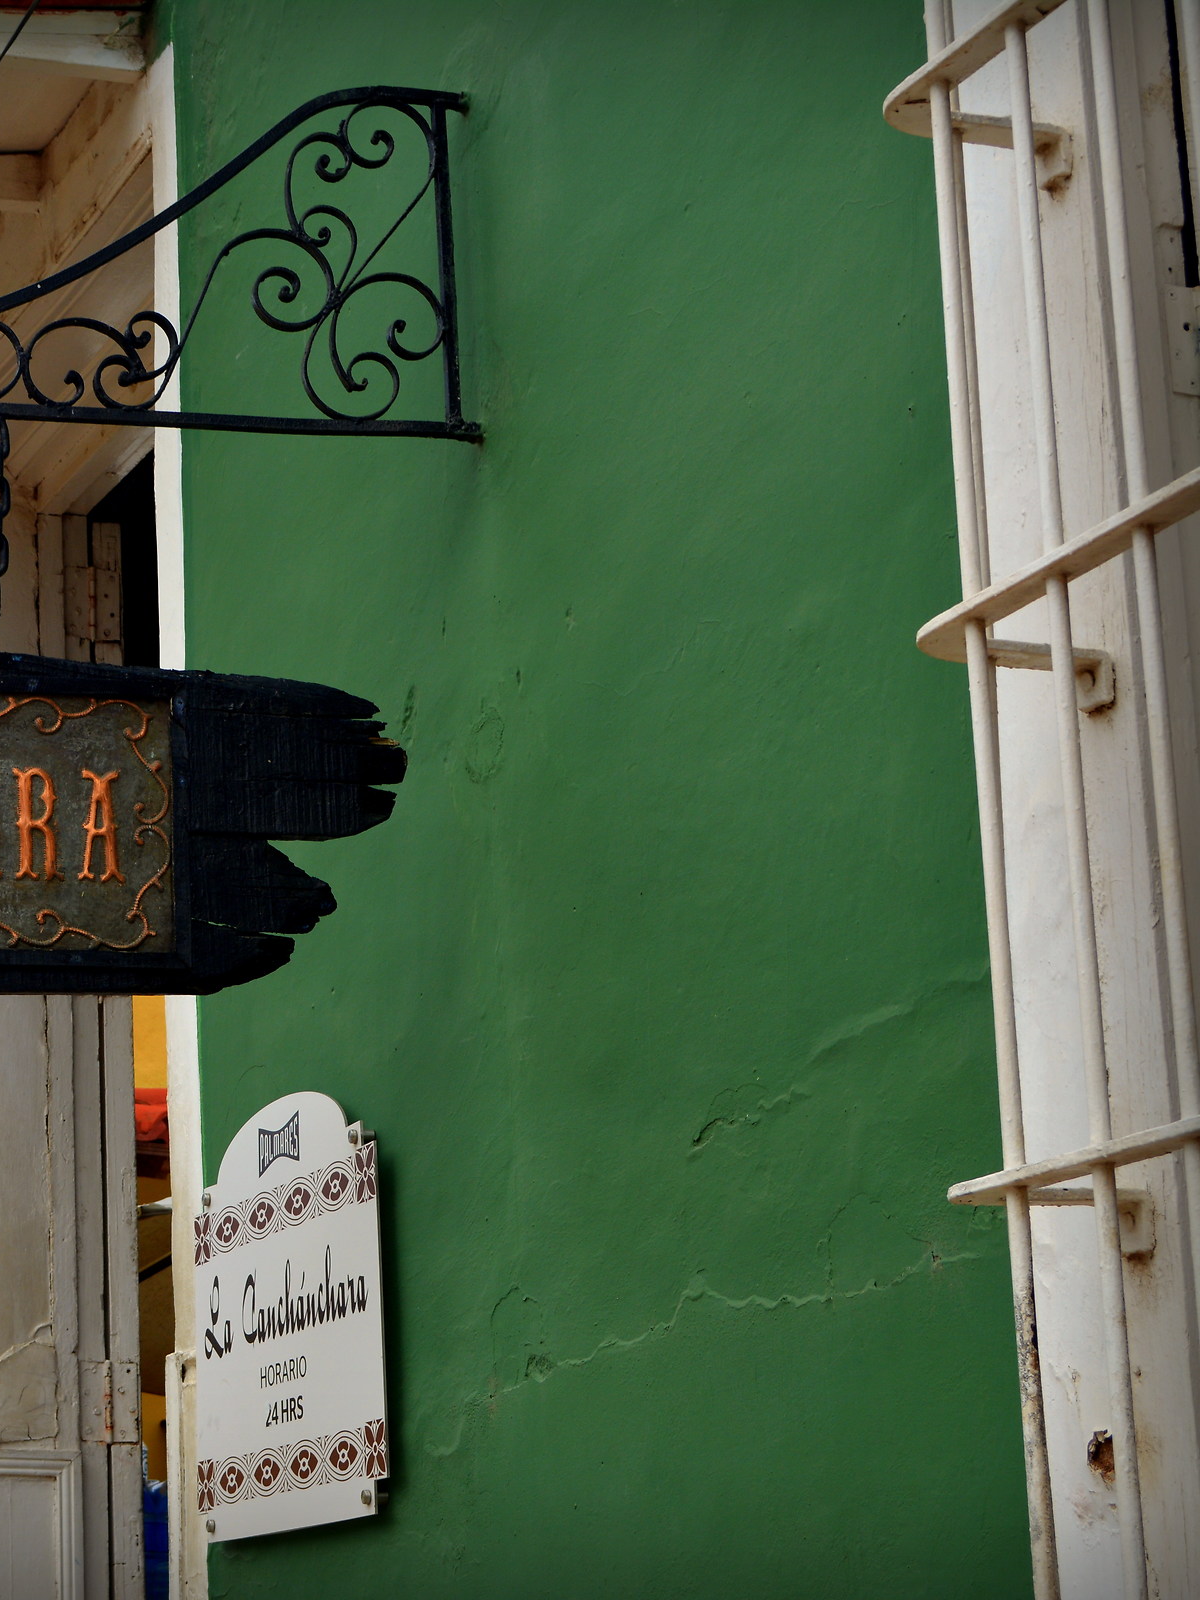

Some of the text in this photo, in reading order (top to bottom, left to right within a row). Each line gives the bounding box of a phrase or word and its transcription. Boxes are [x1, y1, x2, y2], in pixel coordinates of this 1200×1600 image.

[260, 1116, 298, 1172] PALMARES
[204, 1244, 368, 1359] La Canchánchara
[260, 1355, 307, 1389] HORARIO
[281, 1395, 304, 1423] HRS
